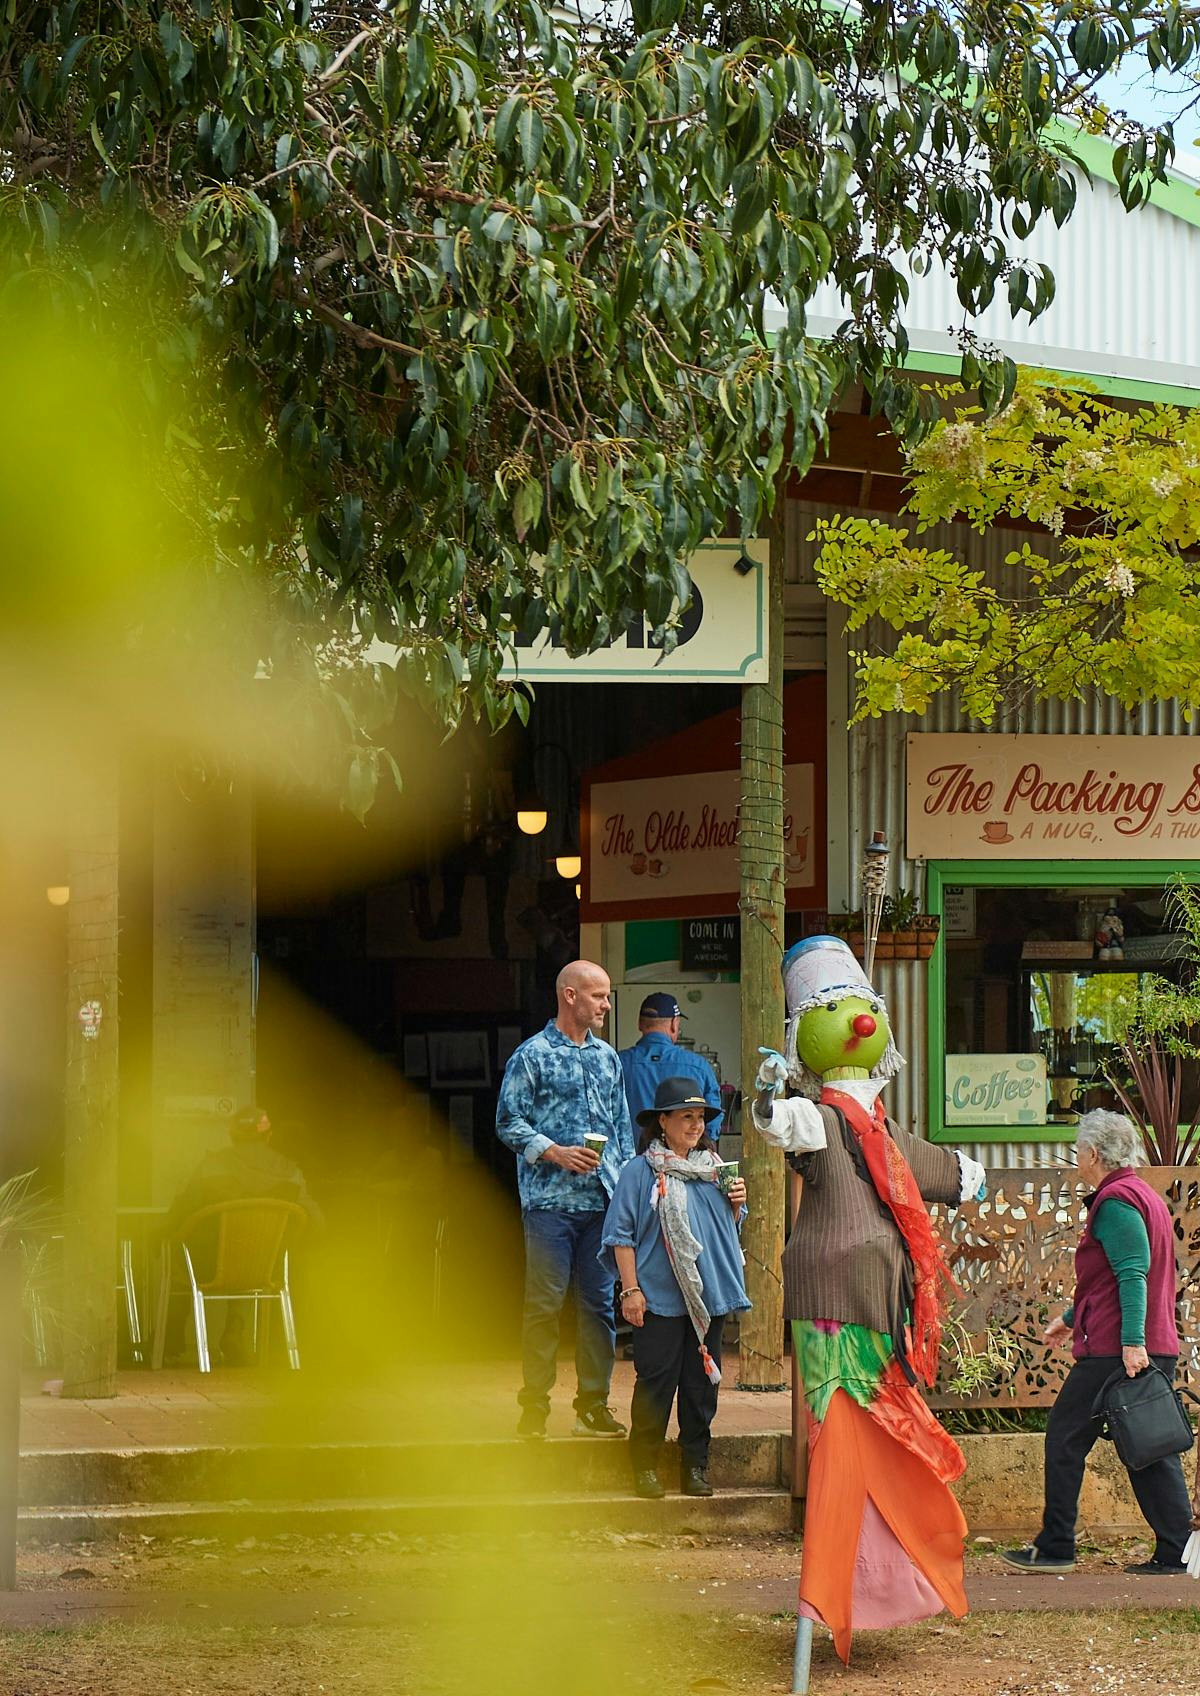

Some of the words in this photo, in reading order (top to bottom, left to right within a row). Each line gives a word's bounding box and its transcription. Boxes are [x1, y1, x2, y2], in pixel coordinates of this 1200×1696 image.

[924, 764, 995, 815] The
[1003, 763, 1164, 836] Packing
[602, 813, 635, 857] The
[644, 810, 690, 853] Olde
[1020, 822, 1034, 839] A
[1042, 822, 1098, 843] MUG,
[1150, 822, 1163, 839] A
[689, 922, 718, 939] COME
[723, 922, 735, 939] IN
[952, 1069, 1035, 1111] Coffee
